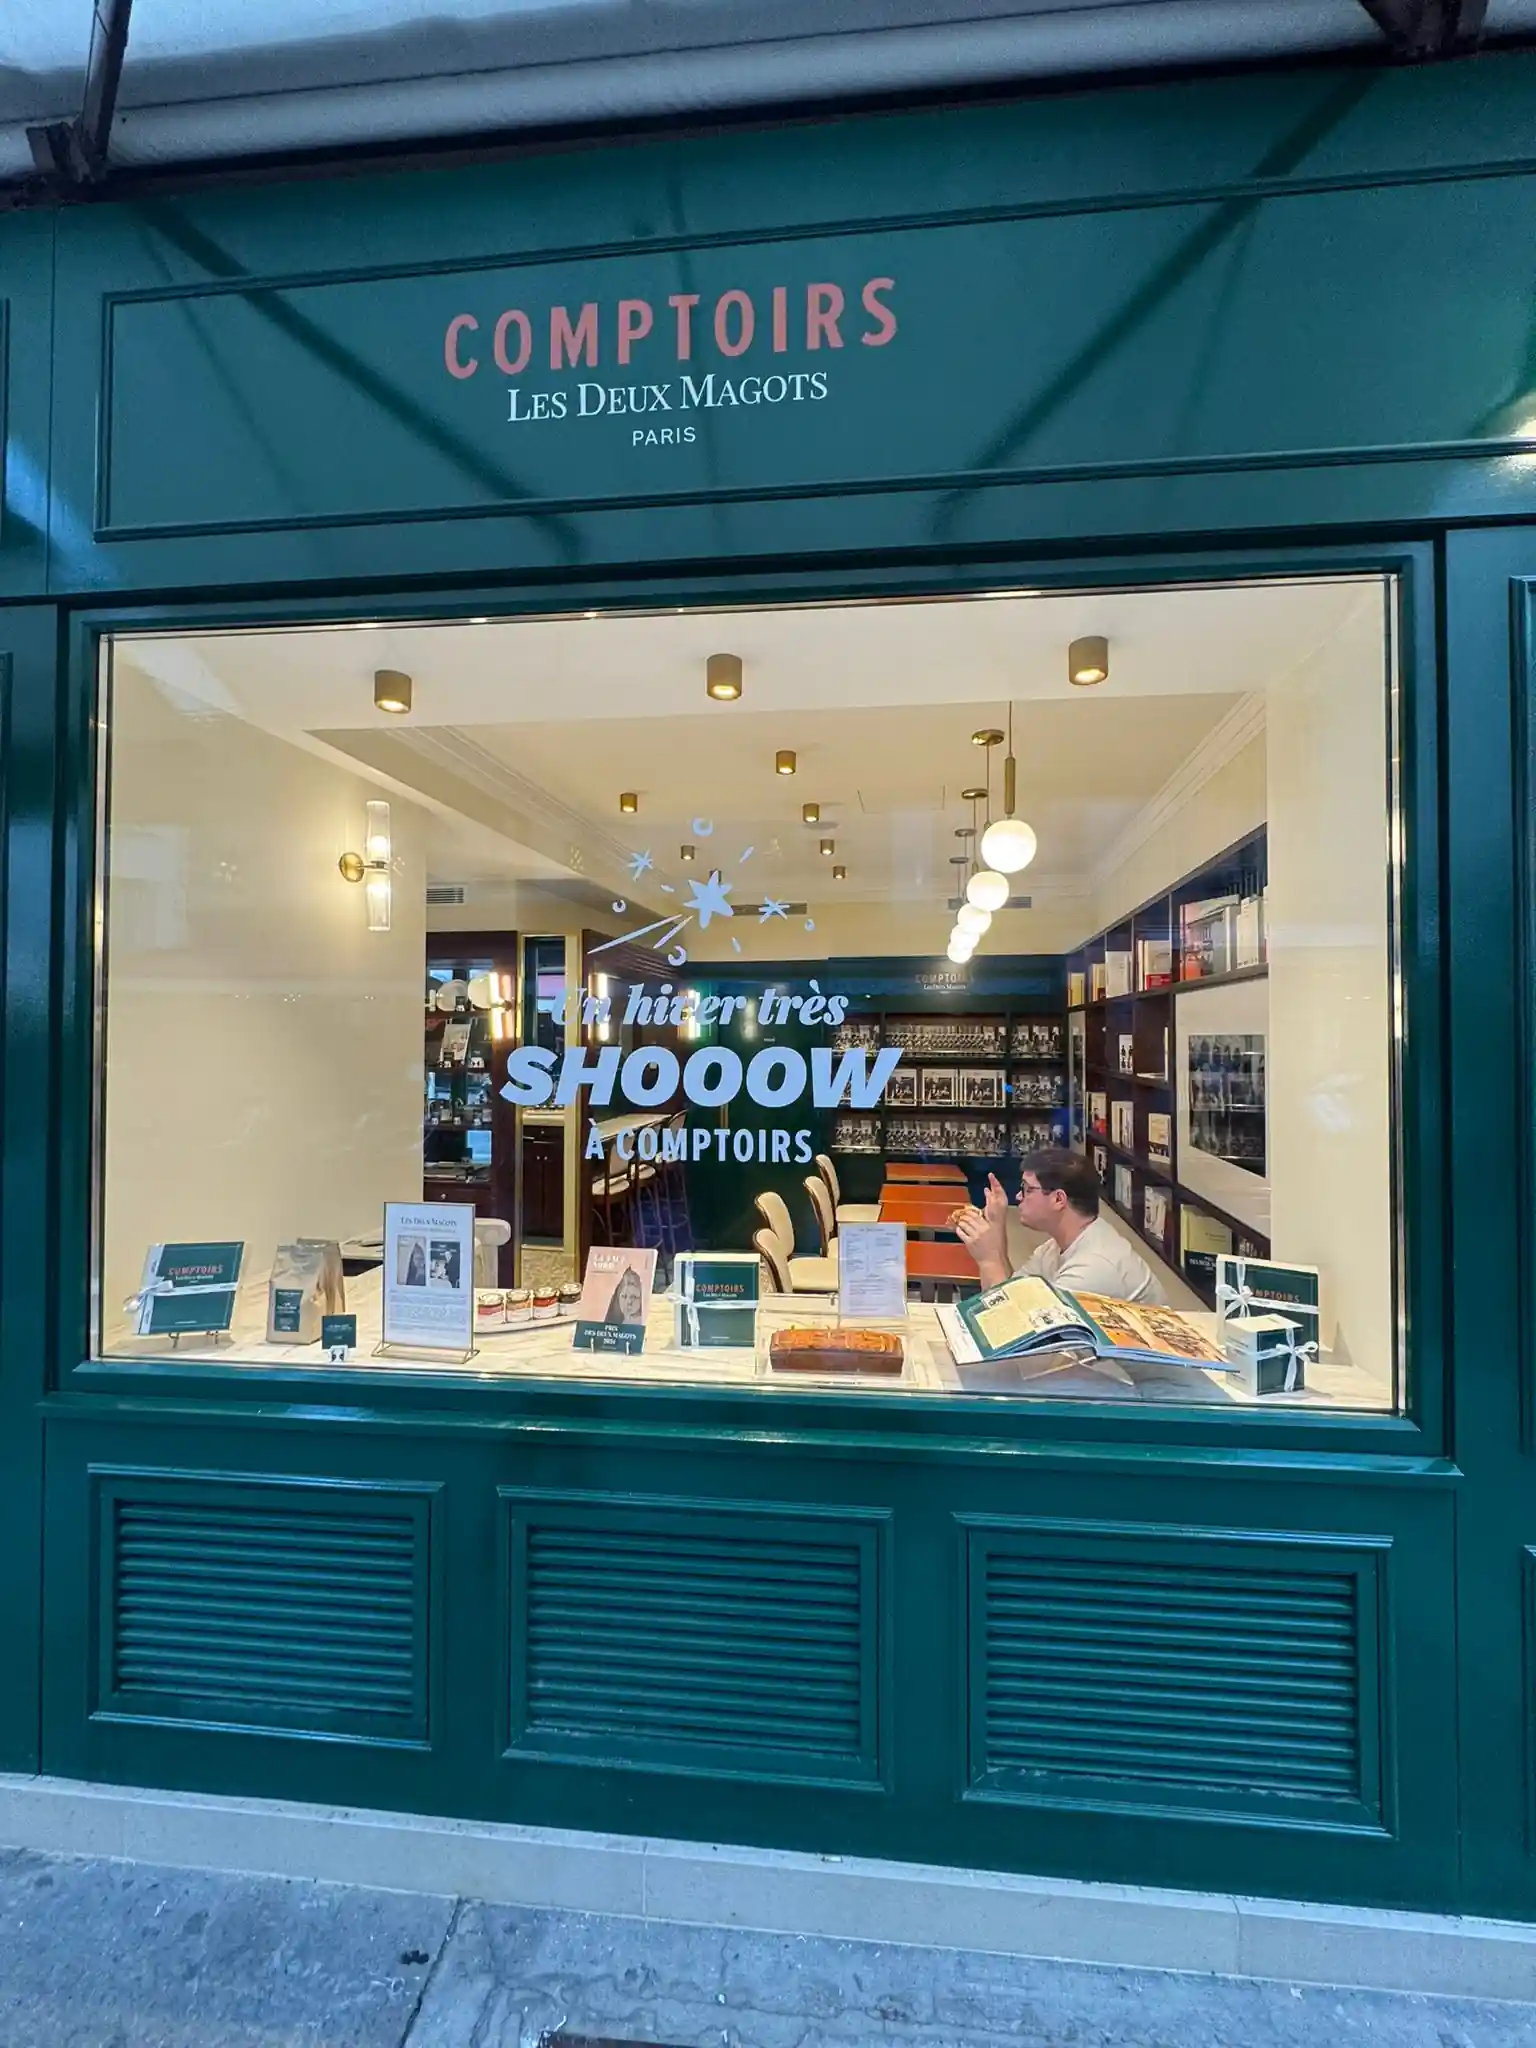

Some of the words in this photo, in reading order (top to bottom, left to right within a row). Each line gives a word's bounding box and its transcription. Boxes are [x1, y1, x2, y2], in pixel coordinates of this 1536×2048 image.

[444, 277, 898, 379] COMPTOIRS
[507, 388, 568, 422] LES
[576, 382, 672, 417] DEUX
[680, 372, 829, 409] MAGOTS
[632, 426, 697, 447] PARIS
[551, 986, 611, 1026] Un
[623, 982, 746, 1026] hiver
[757, 979, 850, 1026] très
[499, 1045, 903, 1109] SHOOOW
[585, 1118, 605, 1160] À
[616, 1128, 813, 1164] COMPTOIRS
[695, 1283, 745, 1293] COMPTOIRS
